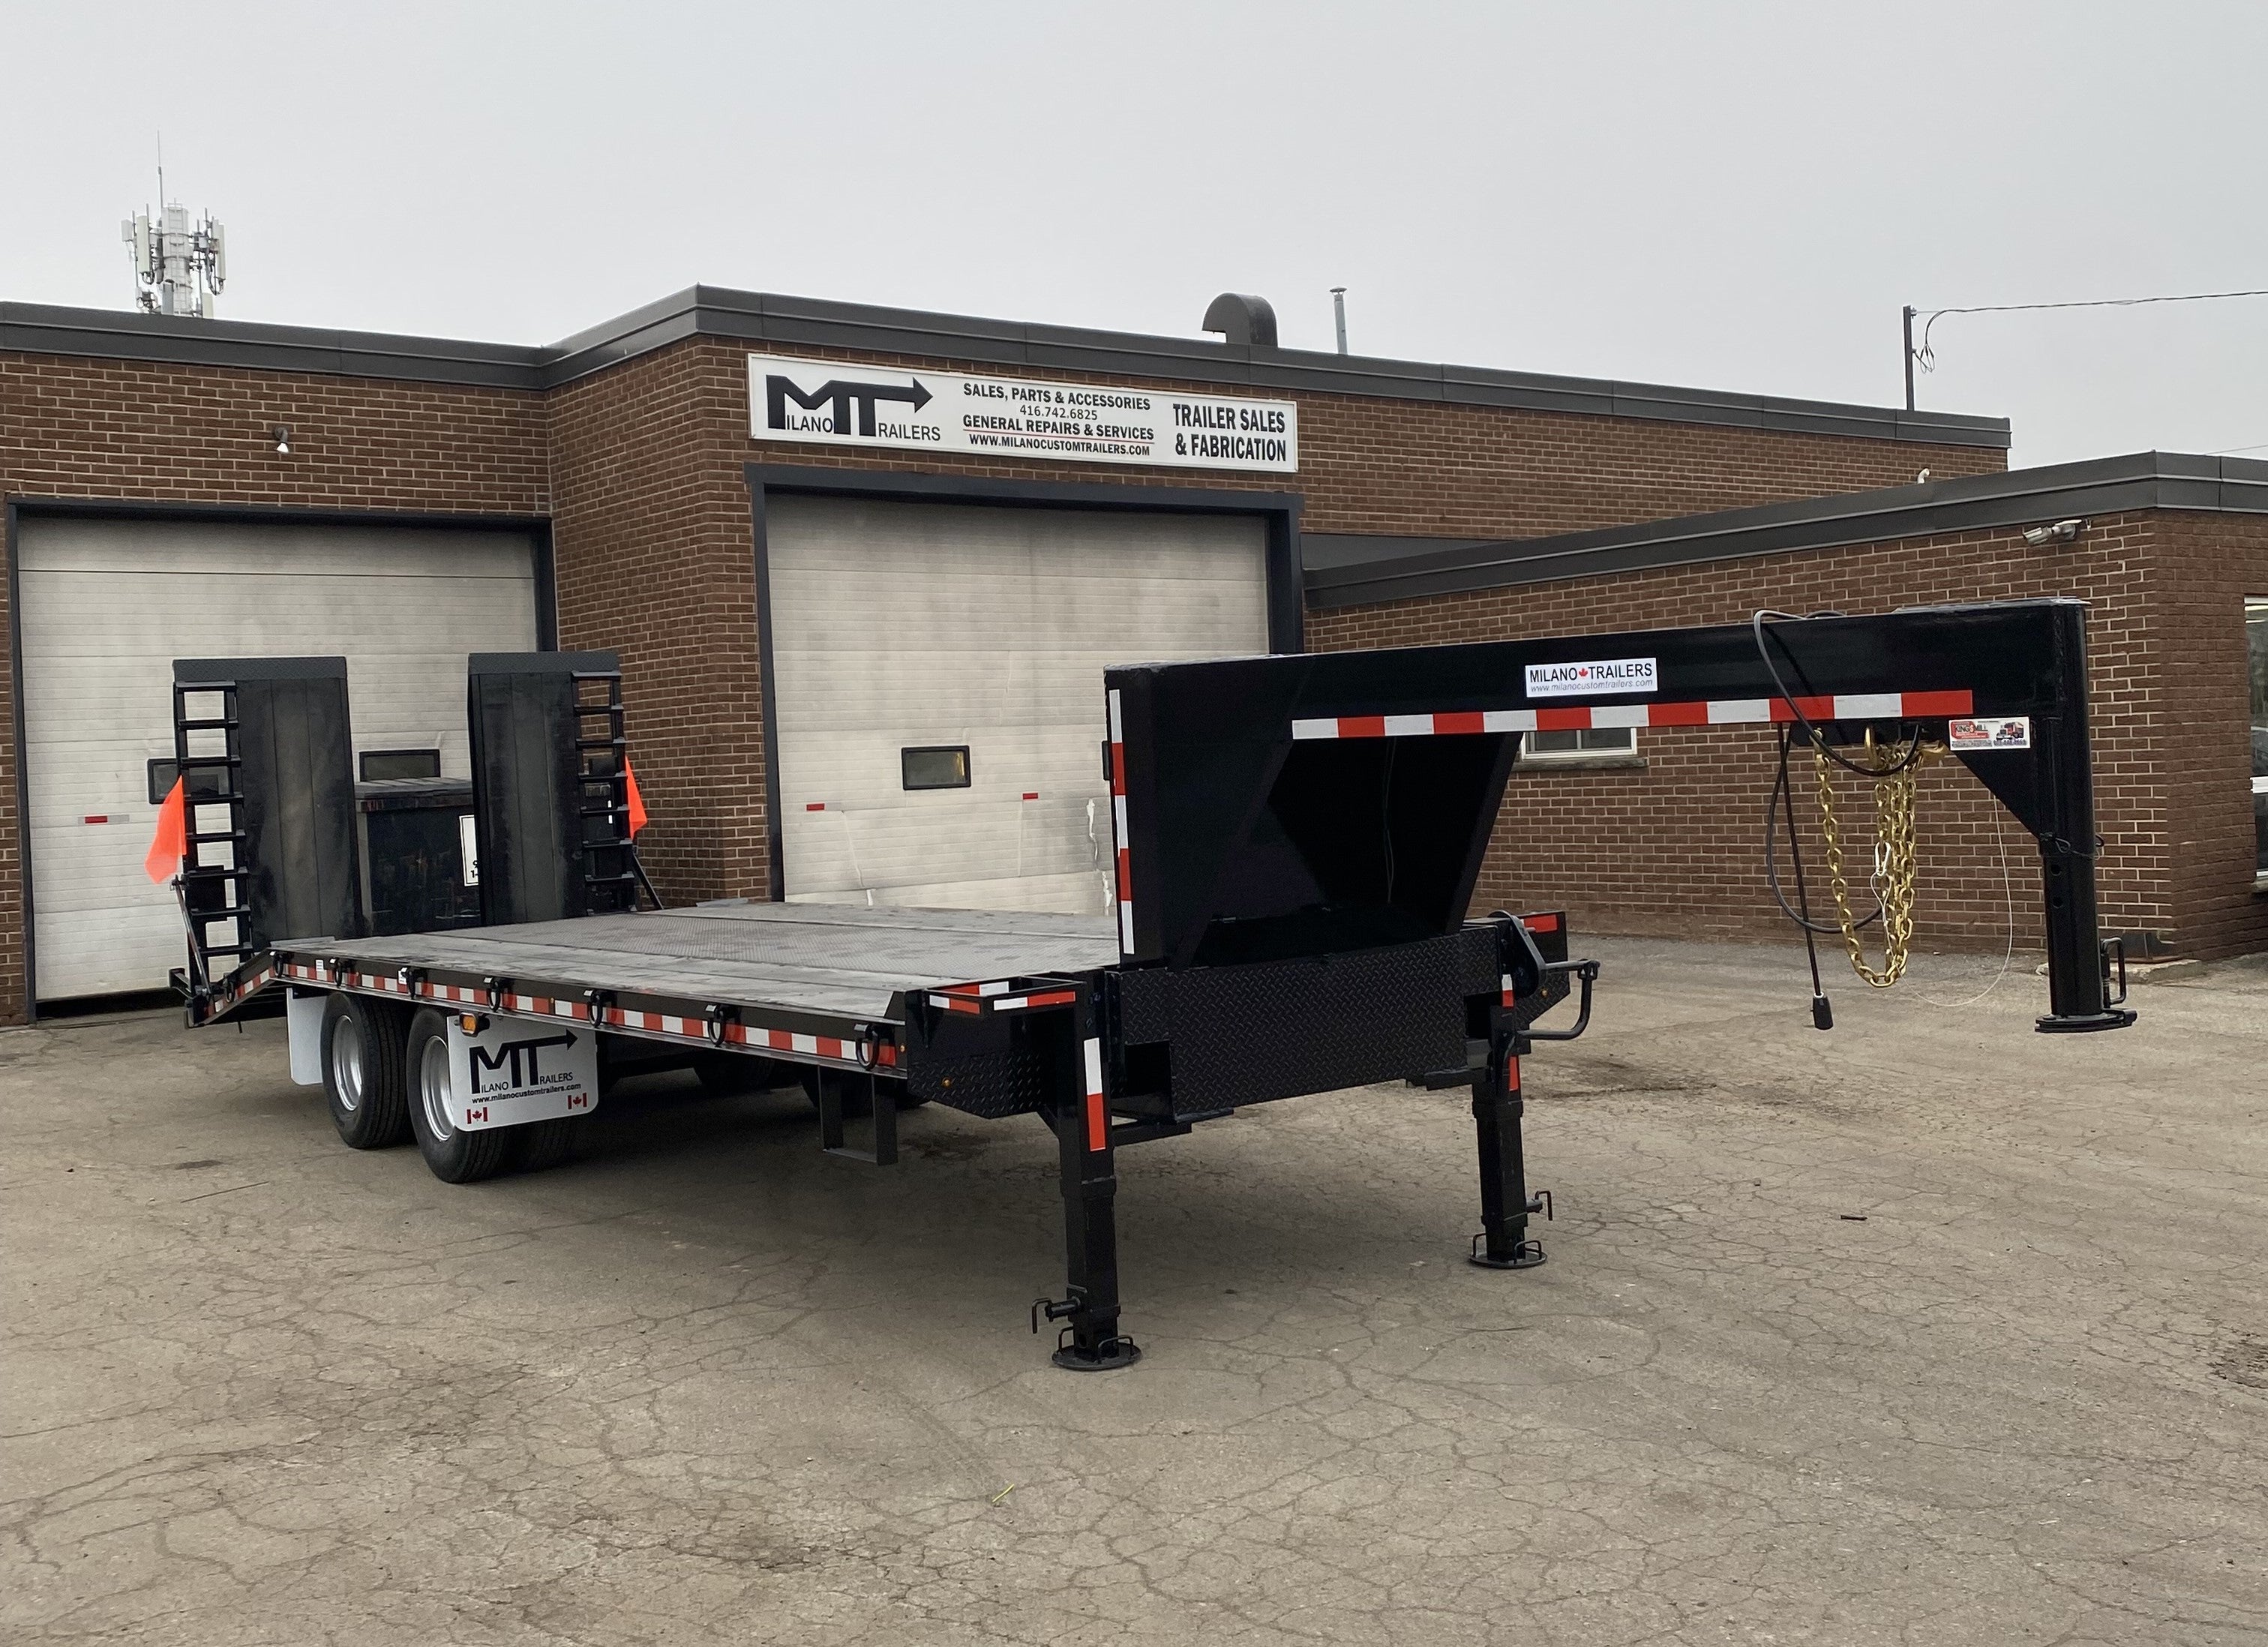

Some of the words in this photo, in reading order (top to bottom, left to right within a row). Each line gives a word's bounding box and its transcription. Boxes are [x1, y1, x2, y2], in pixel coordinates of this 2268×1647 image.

[963, 382, 1008, 402] SALES,
[1012, 386, 1051, 404] PARTS
[1054, 391, 1065, 404] &
[1067, 392, 1150, 410] ACCESSORIES
[1020, 404, 1098, 421] 416.742.6825
[1172, 403, 1236, 430] TRAILER
[1240, 408, 1286, 433] SALES
[963, 414, 1022, 431] GENERAL
[1026, 419, 1080, 435] REPAIRS
[1084, 424, 1094, 436] &
[1096, 424, 1154, 440] SERVICES
[969, 434, 1150, 456] WWW.MILANOCUSTOMTRAILERS.COM
[1175, 433, 1186, 456] &
[1191, 434, 1286, 461] FABRICATION
[1530, 668, 1577, 682] MILANO
[1588, 663, 1652, 680] TRAILERS
[1531, 680, 1653, 692] www.milanocustomtrailers.com
[472, 1083, 581, 1104] www.milanocustomtrailers.com
